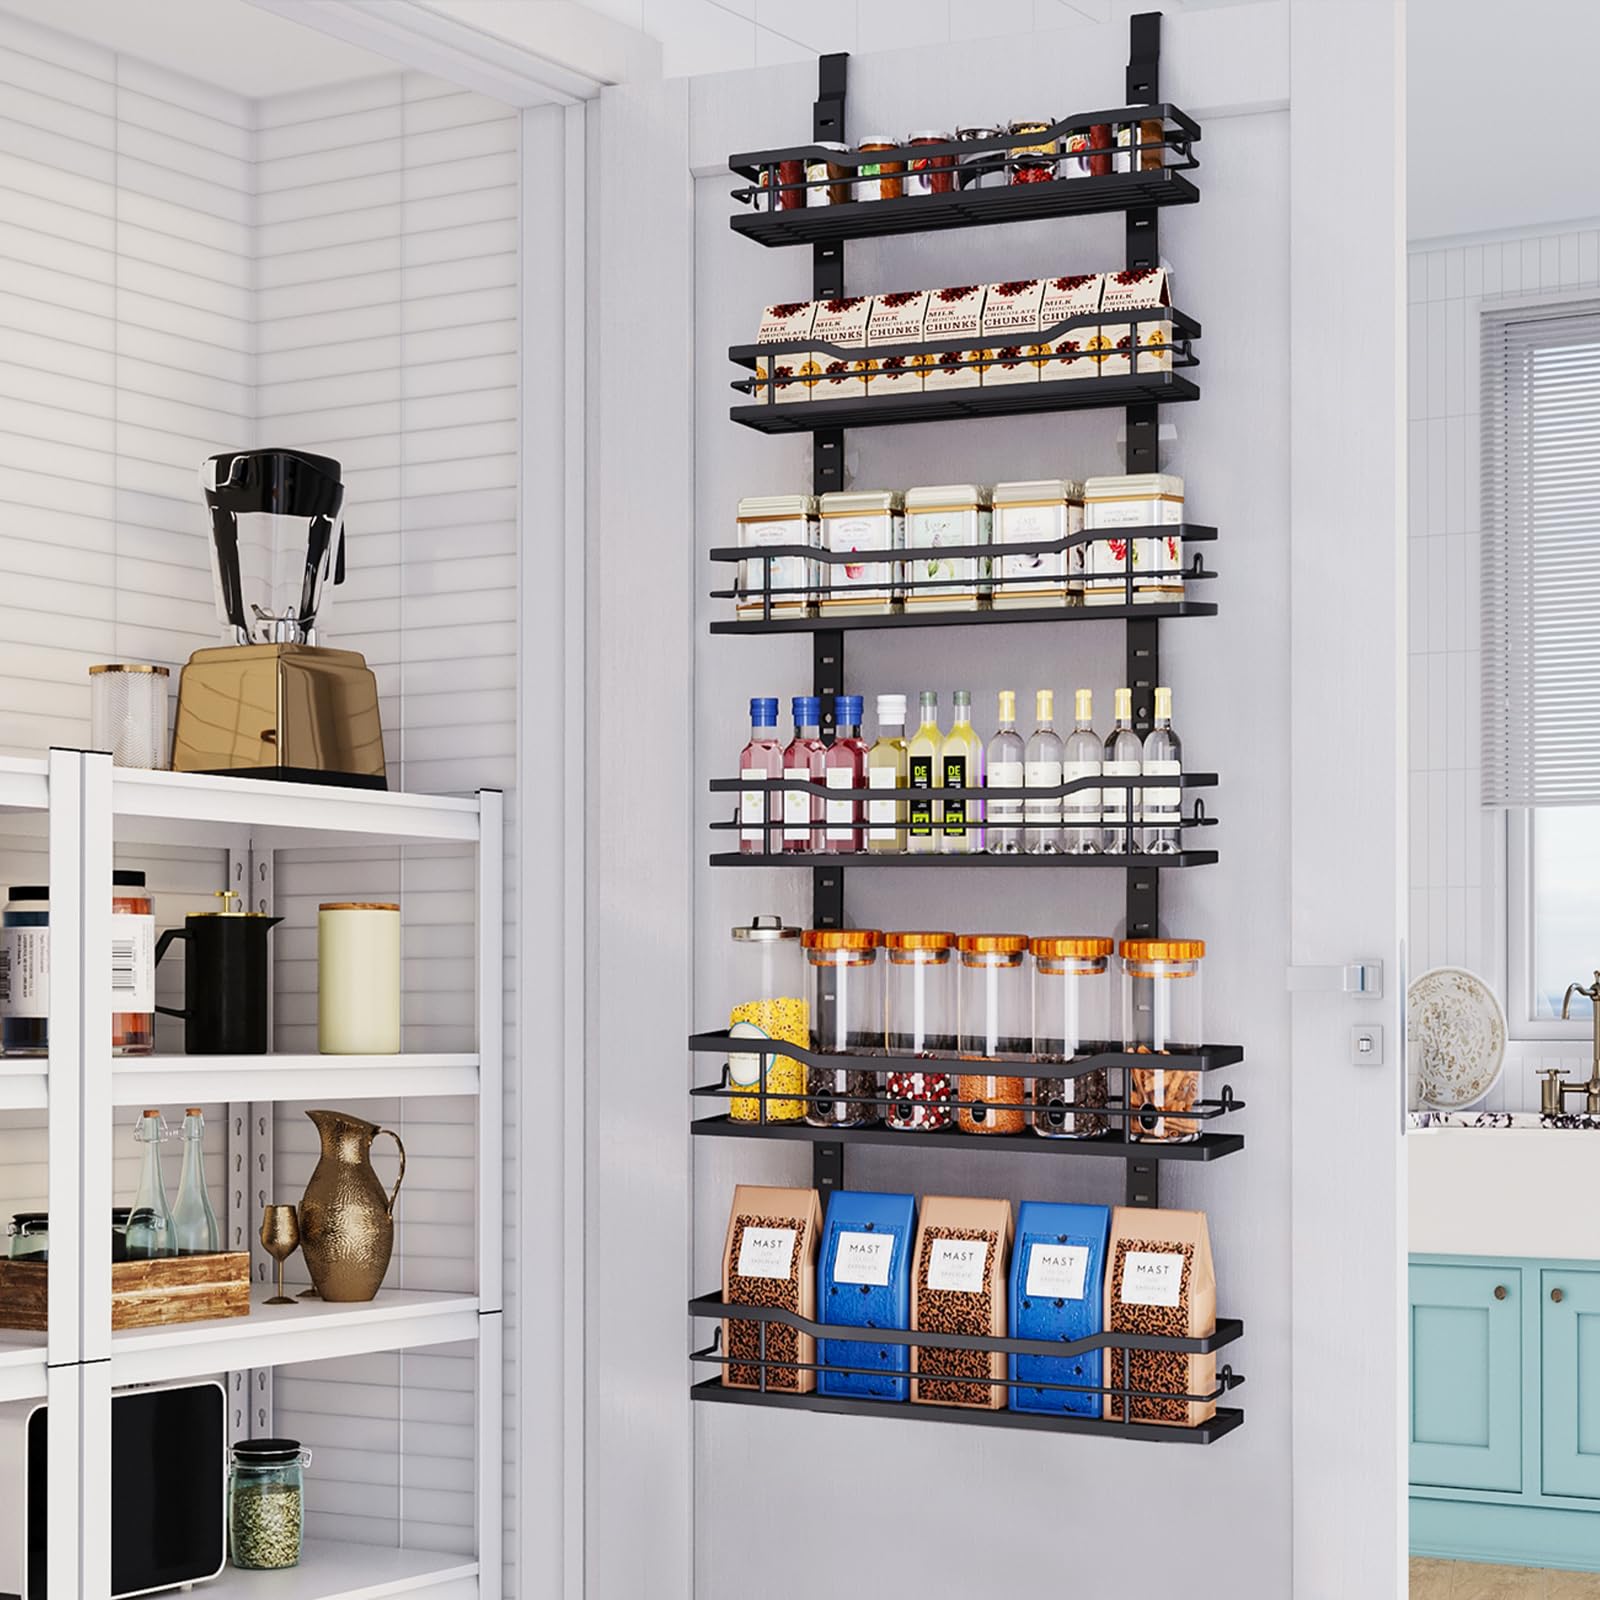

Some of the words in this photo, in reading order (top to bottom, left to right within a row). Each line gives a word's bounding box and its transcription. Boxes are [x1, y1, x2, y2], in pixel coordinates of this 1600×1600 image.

[1104, 298, 1156, 306] CHOCOLATE
[1042, 304, 1094, 312] CHOCOLATE
[926, 314, 976, 323] CHOCOLATE
[984, 309, 1036, 318] CHOCOLATE
[870, 320, 920, 328] CHOCOLATE
[984, 315, 1036, 326] CHUNKS
[814, 325, 863, 334] CHOCOLATE
[870, 325, 920, 336] CHUNKS
[926, 320, 977, 332] CHUNKS
[759, 330, 808, 338] CHOCOLATE
[914, 766, 927, 776] DE
[948, 765, 960, 776] DE
[752, 1240, 784, 1249] MAST
[849, 1244, 880, 1254] MAST
[942, 1252, 974, 1262] MAST
[1042, 1256, 1075, 1267] MAST
[1136, 1264, 1169, 1275] MAST
